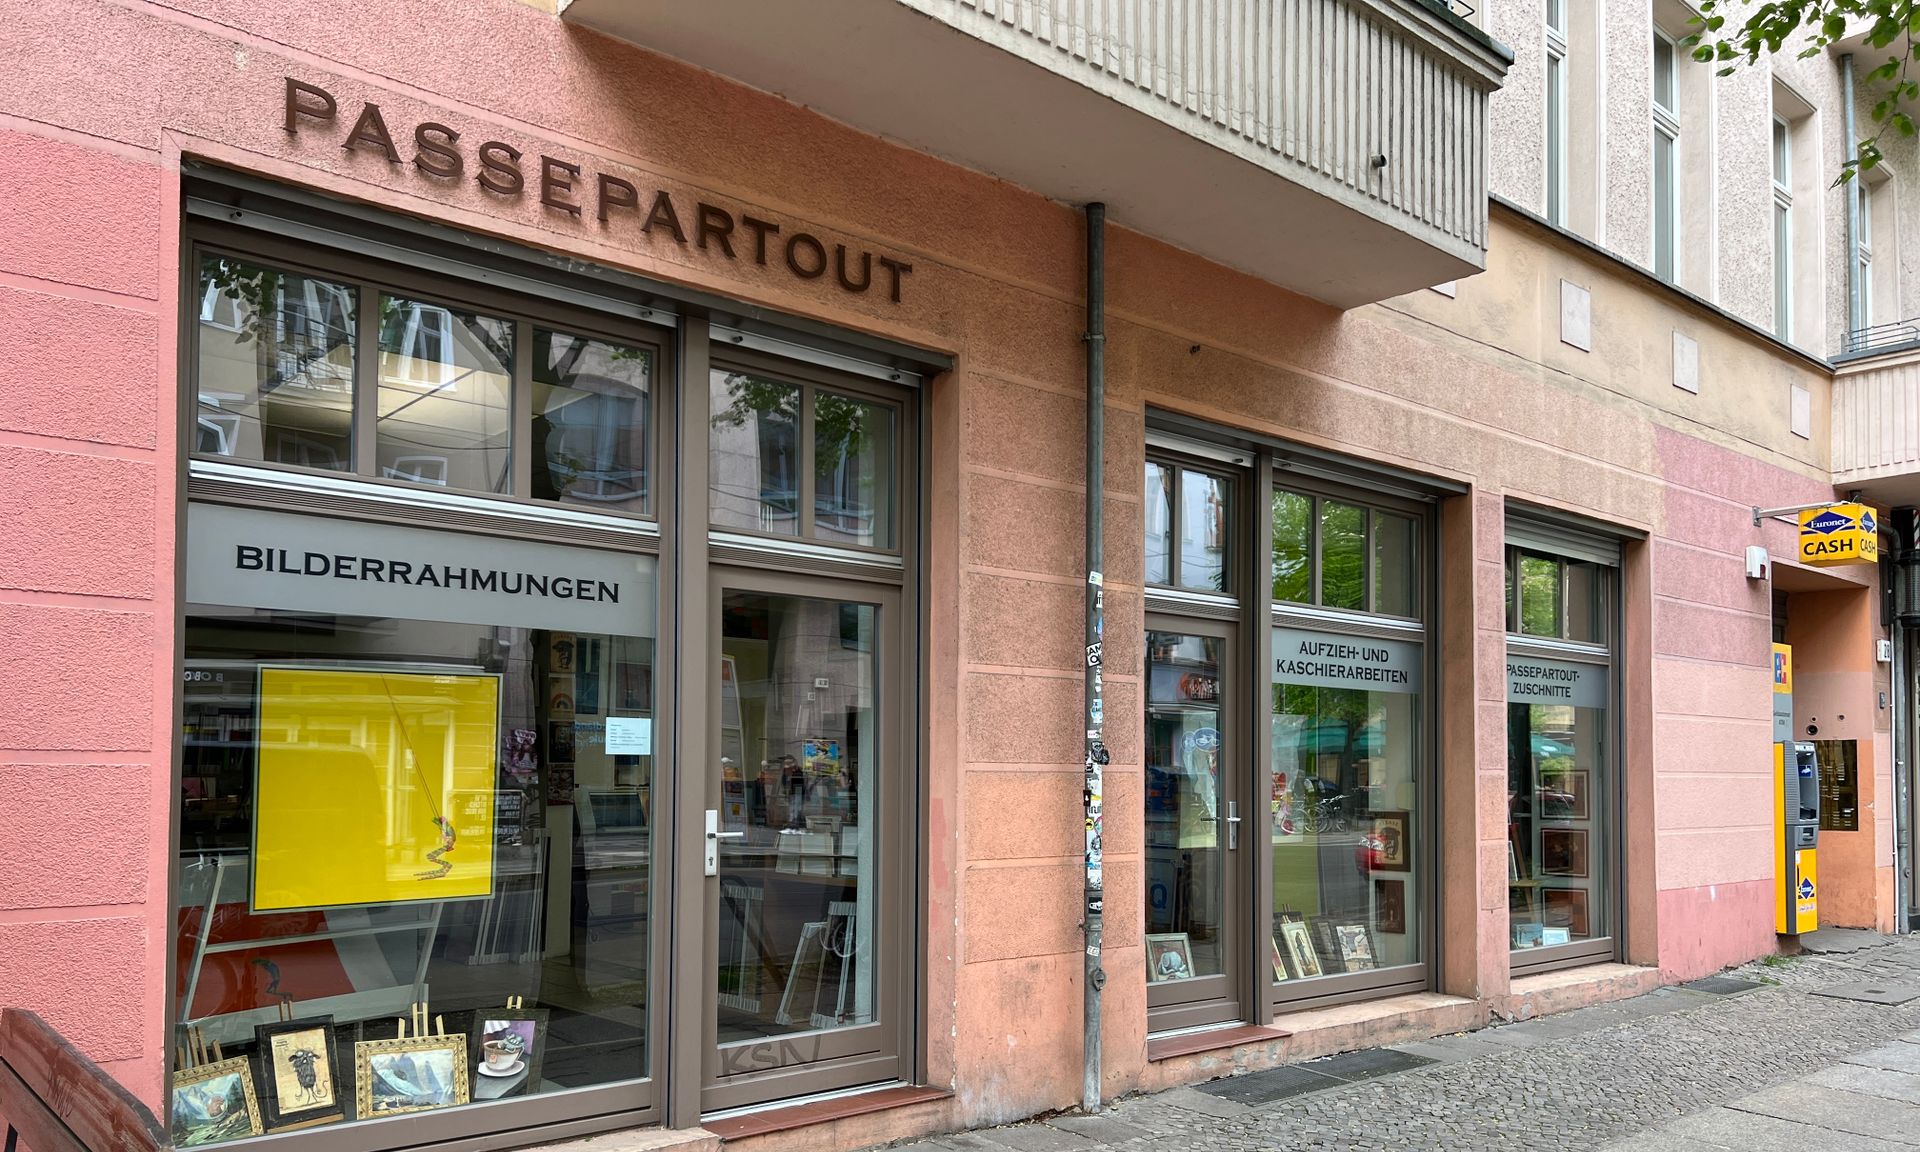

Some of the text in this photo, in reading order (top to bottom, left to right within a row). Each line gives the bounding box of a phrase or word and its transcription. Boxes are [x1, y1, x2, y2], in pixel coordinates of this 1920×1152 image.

[283, 76, 913, 303] PASSEPARTOUT
[1811, 519, 1846, 529] Euronet
[1803, 538, 1853, 556] CASH
[1860, 538, 1876, 555] CASH
[235, 544, 620, 604] BILDERRAHMUNGEN
[1299, 641, 1389, 663] AUFZIEH- UND
[1276, 659, 1408, 683] KASCHIERARBEITEN
[1507, 664, 1580, 682] PASSEPARTOUT-
[1513, 682, 1572, 698] ZUSCHNITTE
